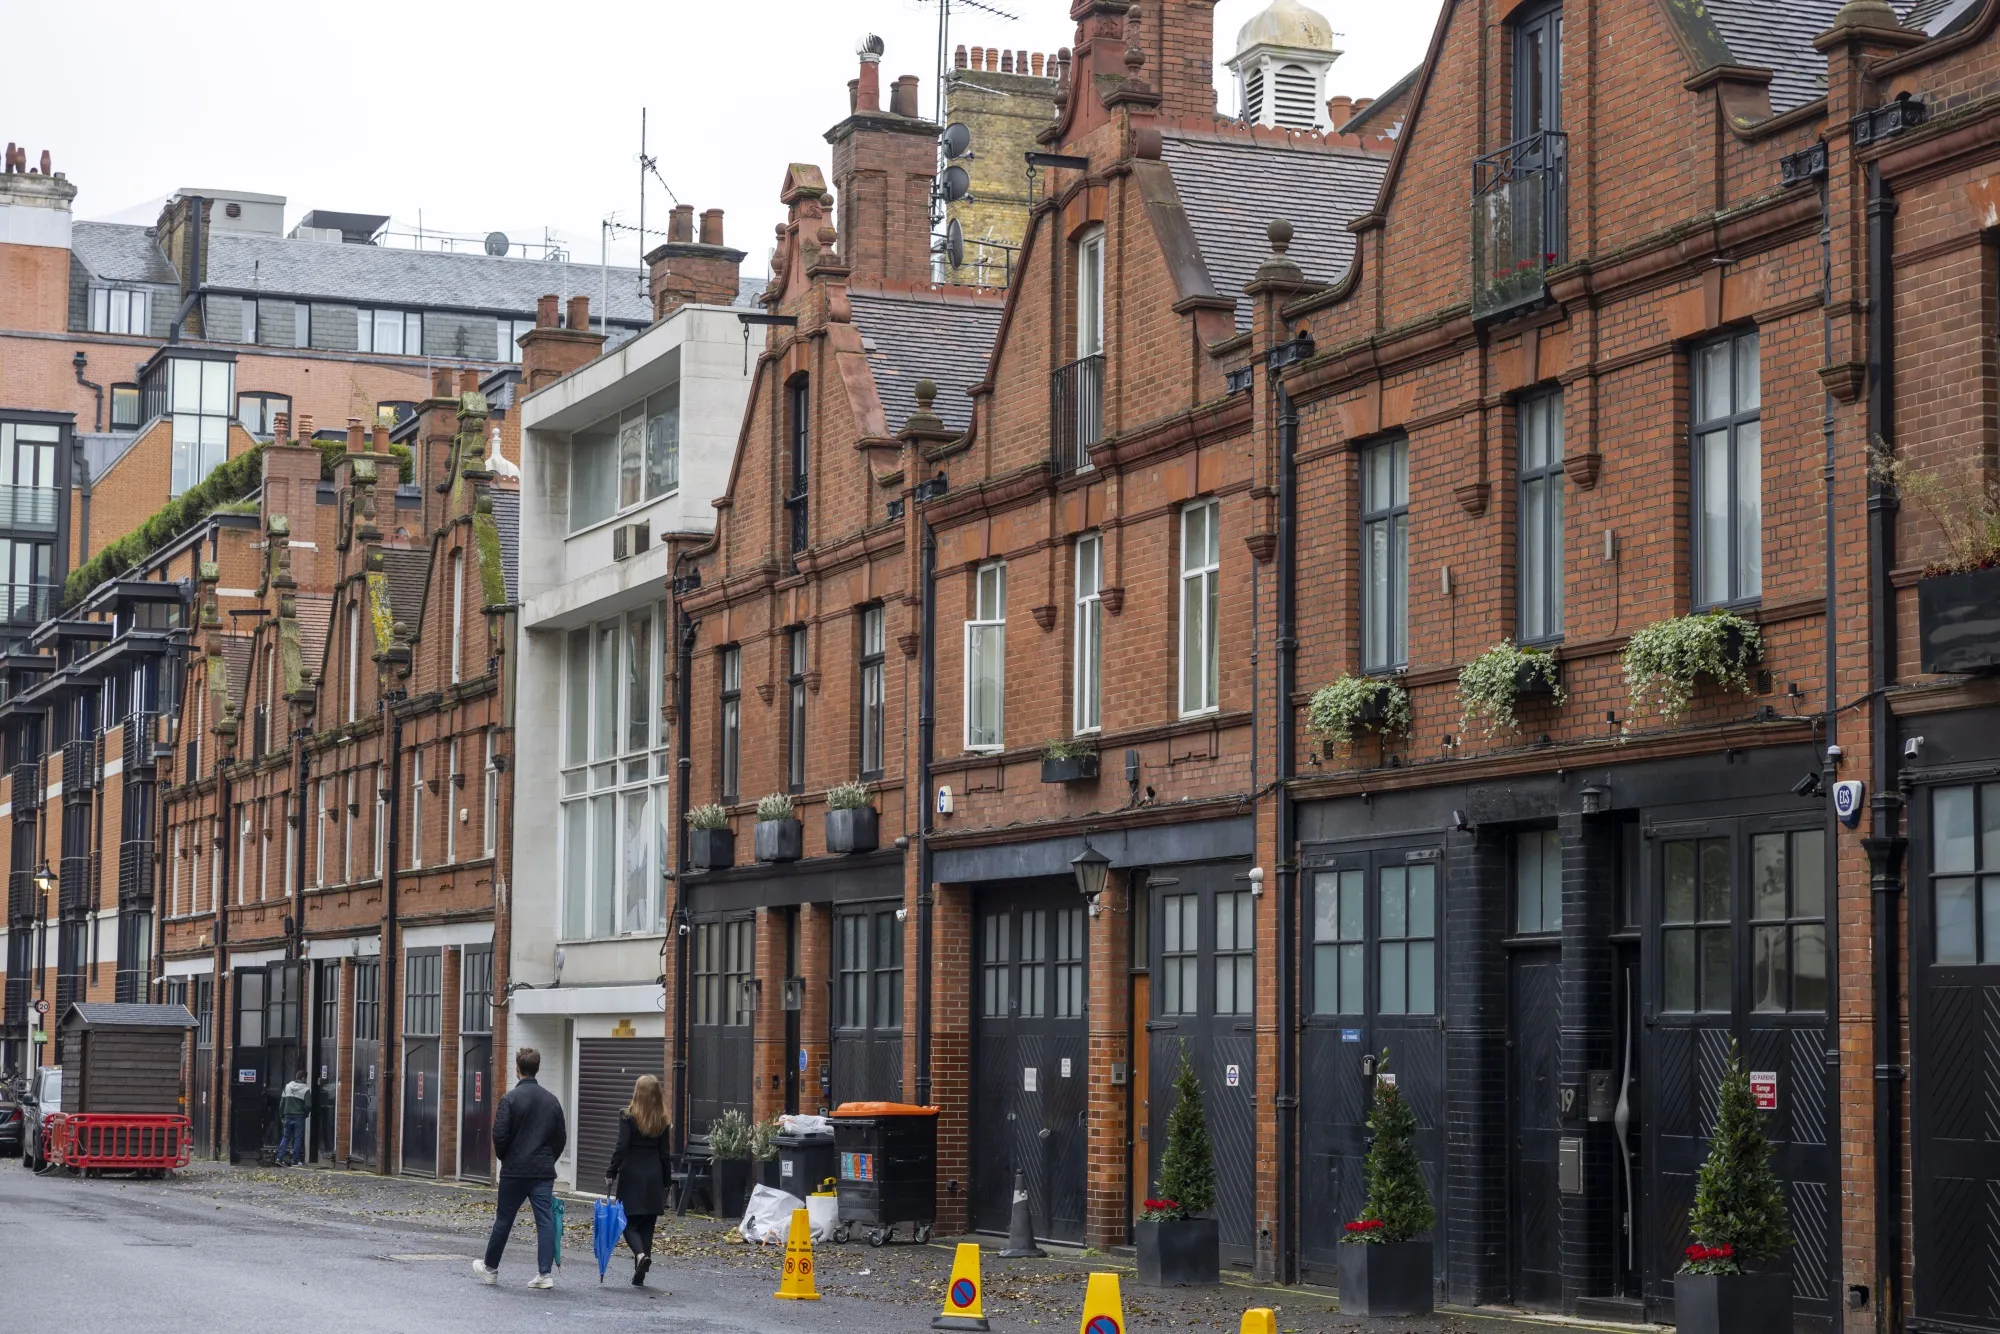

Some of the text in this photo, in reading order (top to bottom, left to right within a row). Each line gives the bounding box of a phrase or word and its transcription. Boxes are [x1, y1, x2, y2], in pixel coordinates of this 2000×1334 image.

[1840, 790, 1850, 804] ECS
[1756, 1084, 1770, 1092] Garage
[1560, 1089, 1574, 1112] 19
